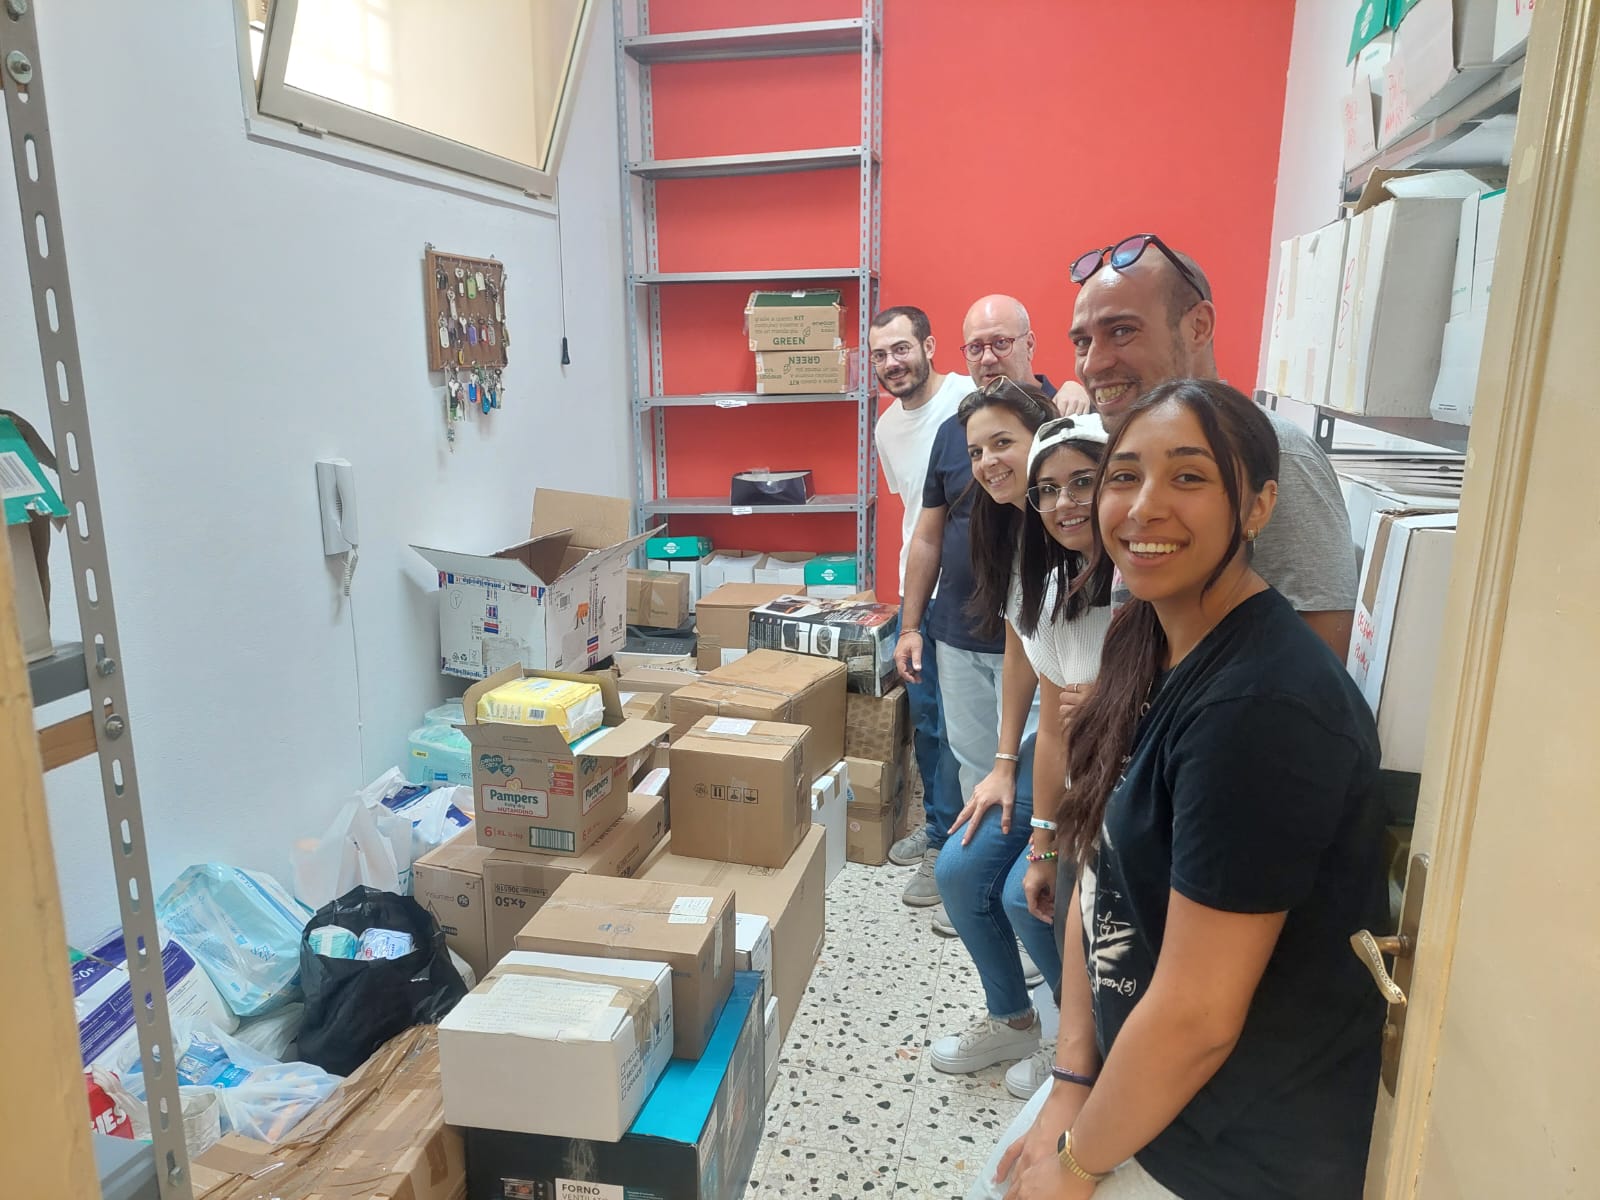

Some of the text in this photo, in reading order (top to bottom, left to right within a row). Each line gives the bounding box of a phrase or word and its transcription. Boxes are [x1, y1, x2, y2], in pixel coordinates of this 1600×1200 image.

[772, 336, 806, 345] GREEN
[788, 356, 821, 365] GREEN
[490, 789, 539, 805] Pampers
[483, 825, 493, 837] 6
[561, 1183, 601, 1196] FORNO
